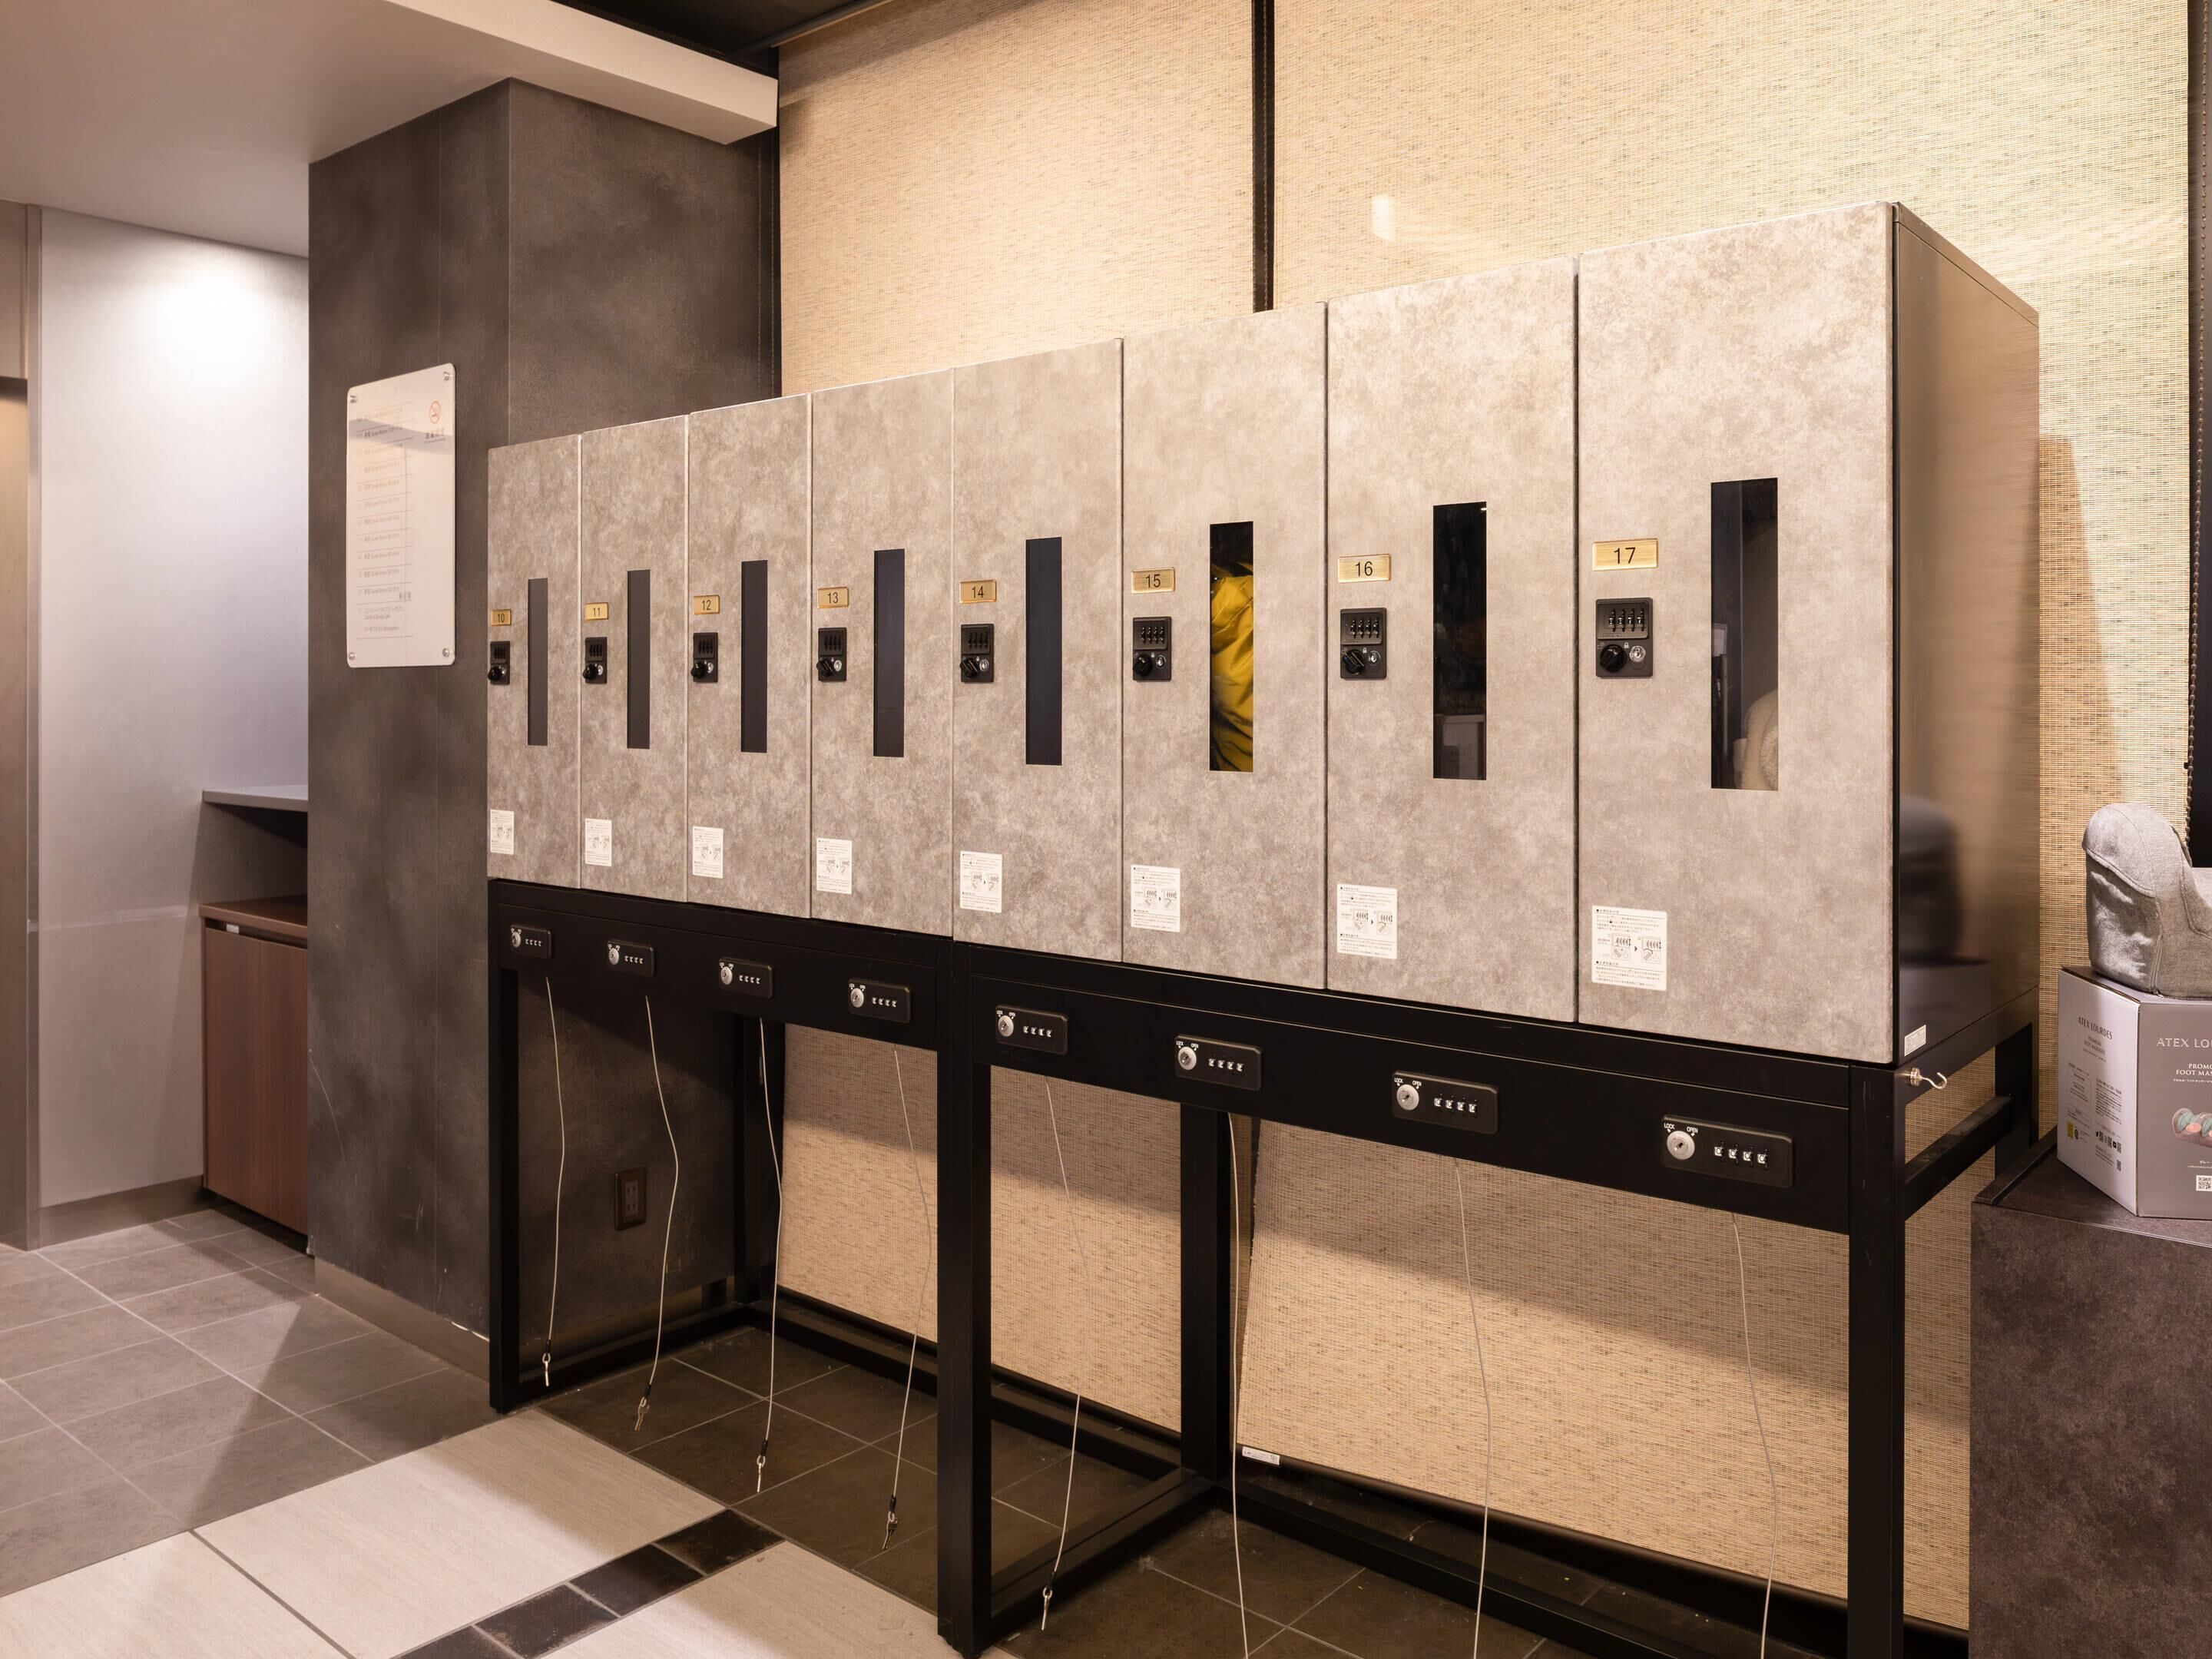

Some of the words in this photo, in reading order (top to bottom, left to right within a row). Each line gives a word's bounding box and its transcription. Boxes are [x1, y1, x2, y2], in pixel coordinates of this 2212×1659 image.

[1614, 547, 1636, 565] 17
[1355, 561, 1373, 578] 16
[1145, 574, 1161, 588] 15
[827, 591, 839, 604] 13
[972, 585, 984, 599] 14
[701, 599, 712, 611] 12
[497, 613, 505, 624] 10
[593, 607, 601, 618] 11
[2078, 1016, 2090, 1029] ATEX
[2091, 1022, 2113, 1040] LOURDES
[2156, 1038, 2190, 1048] ATEX
[2194, 1038, 2212, 1048] LO
